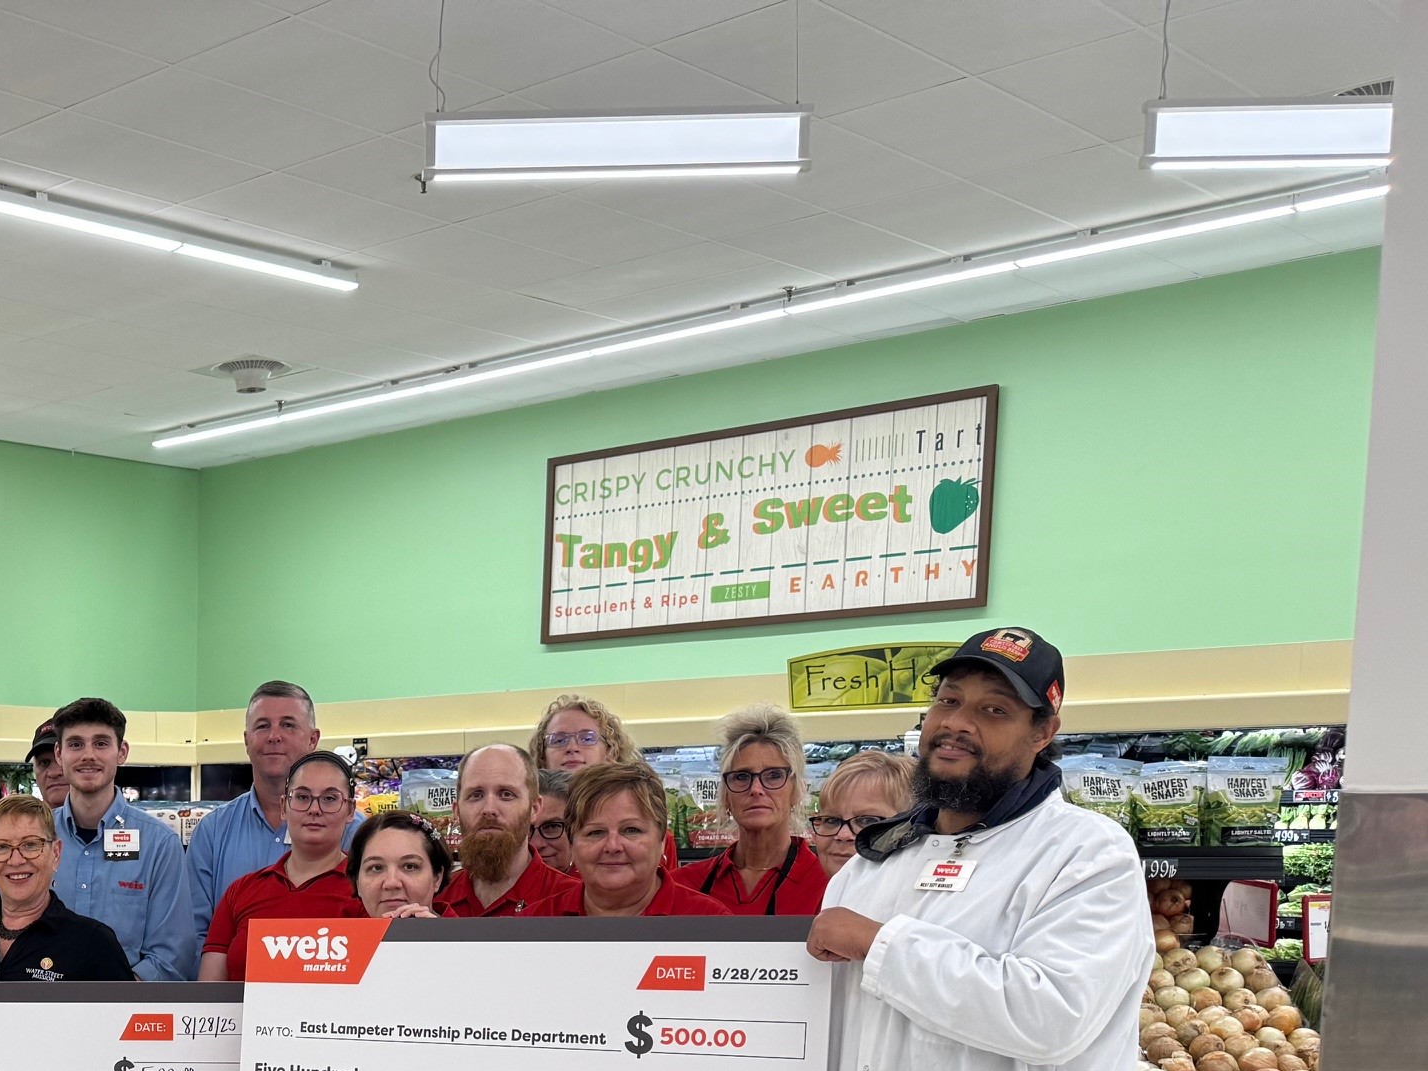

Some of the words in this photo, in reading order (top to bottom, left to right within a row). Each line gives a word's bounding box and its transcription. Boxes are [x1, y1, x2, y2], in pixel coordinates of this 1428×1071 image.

[916, 422, 982, 454] Tart
[555, 472, 645, 506] CRISPY
[656, 449, 796, 491] CRUNCHY
[555, 529, 679, 574] Tangy
[697, 512, 731, 550] &
[752, 484, 913, 536] Sweet
[724, 584, 758, 600] ZESTY
[554, 598, 636, 618] Succulent
[643, 597, 653, 609] &
[661, 591, 699, 609] Ripe
[805, 661, 879, 696] Fresh
[696, 780, 719, 791] HARV
[1083, 776, 1122, 788] HARVEST
[1143, 778, 1188, 794] HARVEST
[1227, 777, 1267, 790] HARVEST
[428, 787, 456, 799] HARVE
[702, 790, 718, 800] SNA
[1090, 786, 1119, 797] SNAPS
[1151, 788, 1185, 800] SNAPS
[1233, 788, 1265, 798] SNAPS
[433, 797, 456, 807] SNAP
[936, 866, 959, 874] weis
[261, 927, 349, 961] weis
[303, 961, 348, 973] markets
[656, 966, 696, 981] DATE:
[712, 966, 799, 983] 8/28/2025
[134, 1022, 166, 1033] DATE:
[181, 1015, 236, 1040] 8/28/25
[255, 1025, 275, 1037] PAY
[276, 1026, 294, 1038] TO:
[300, 1020, 327, 1036] East
[330, 1021, 394, 1041] Lampeter
[396, 1024, 460, 1044] Township
[464, 1026, 507, 1043] Police
[511, 1028, 607, 1049] Department
